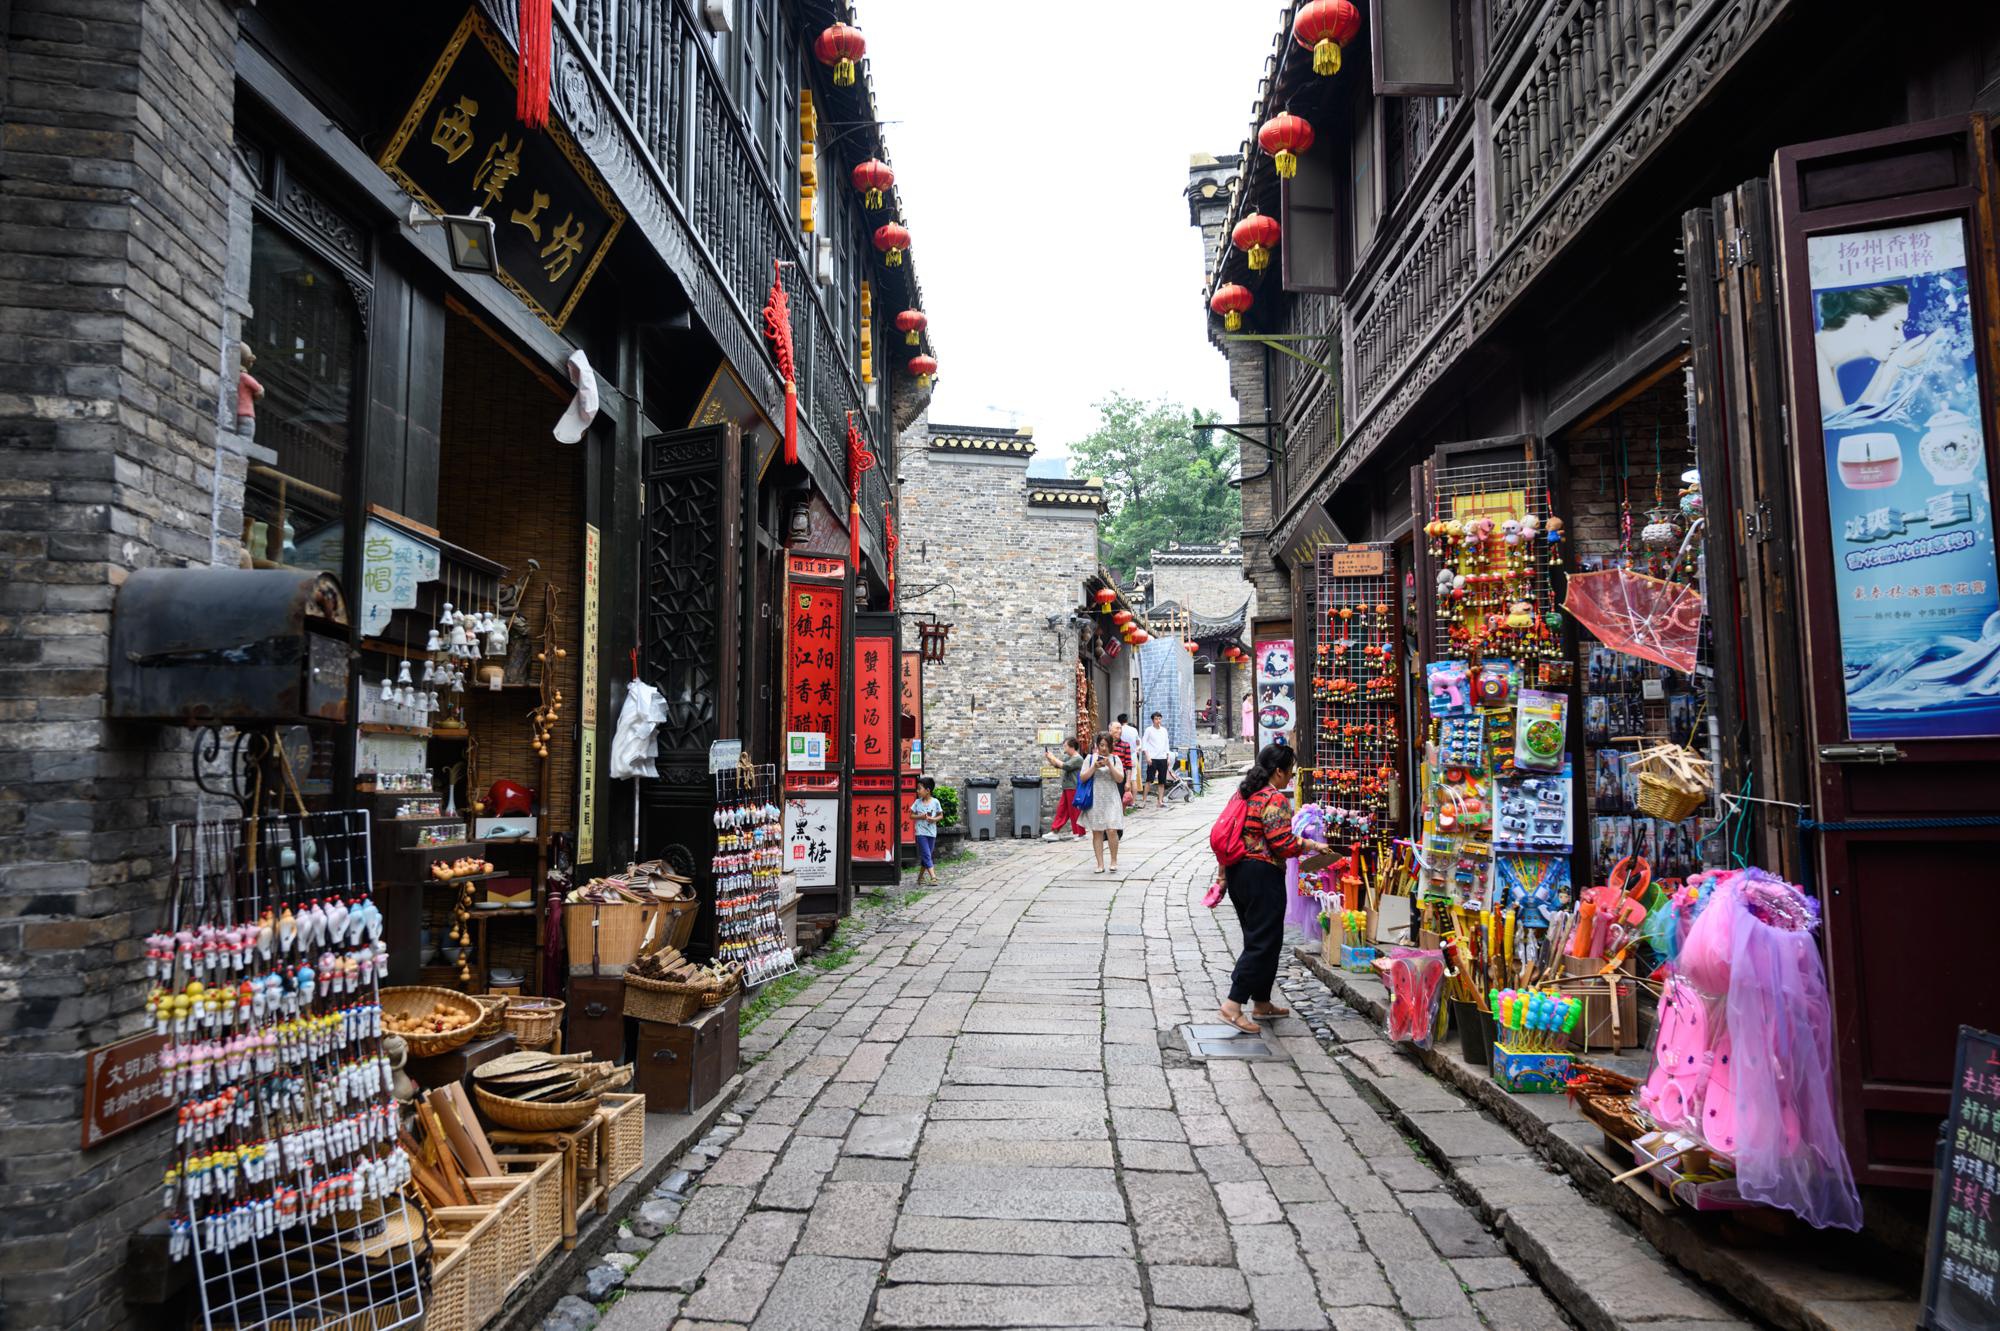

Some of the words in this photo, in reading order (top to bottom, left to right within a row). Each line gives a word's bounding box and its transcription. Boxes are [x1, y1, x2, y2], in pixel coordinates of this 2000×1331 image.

[431, 95, 584, 282] 西津工坊
[1838, 231, 1932, 260] 扬州香粉
[1839, 250, 1933, 276] 中华国粹
[365, 537, 393, 593] 草帽
[814, 614, 836, 735] 丹阳黄酒
[860, 650, 881, 755] 蟹黄汤包
[790, 819, 832, 863] 黑糖
[105, 1052, 160, 1089] 文明旅
